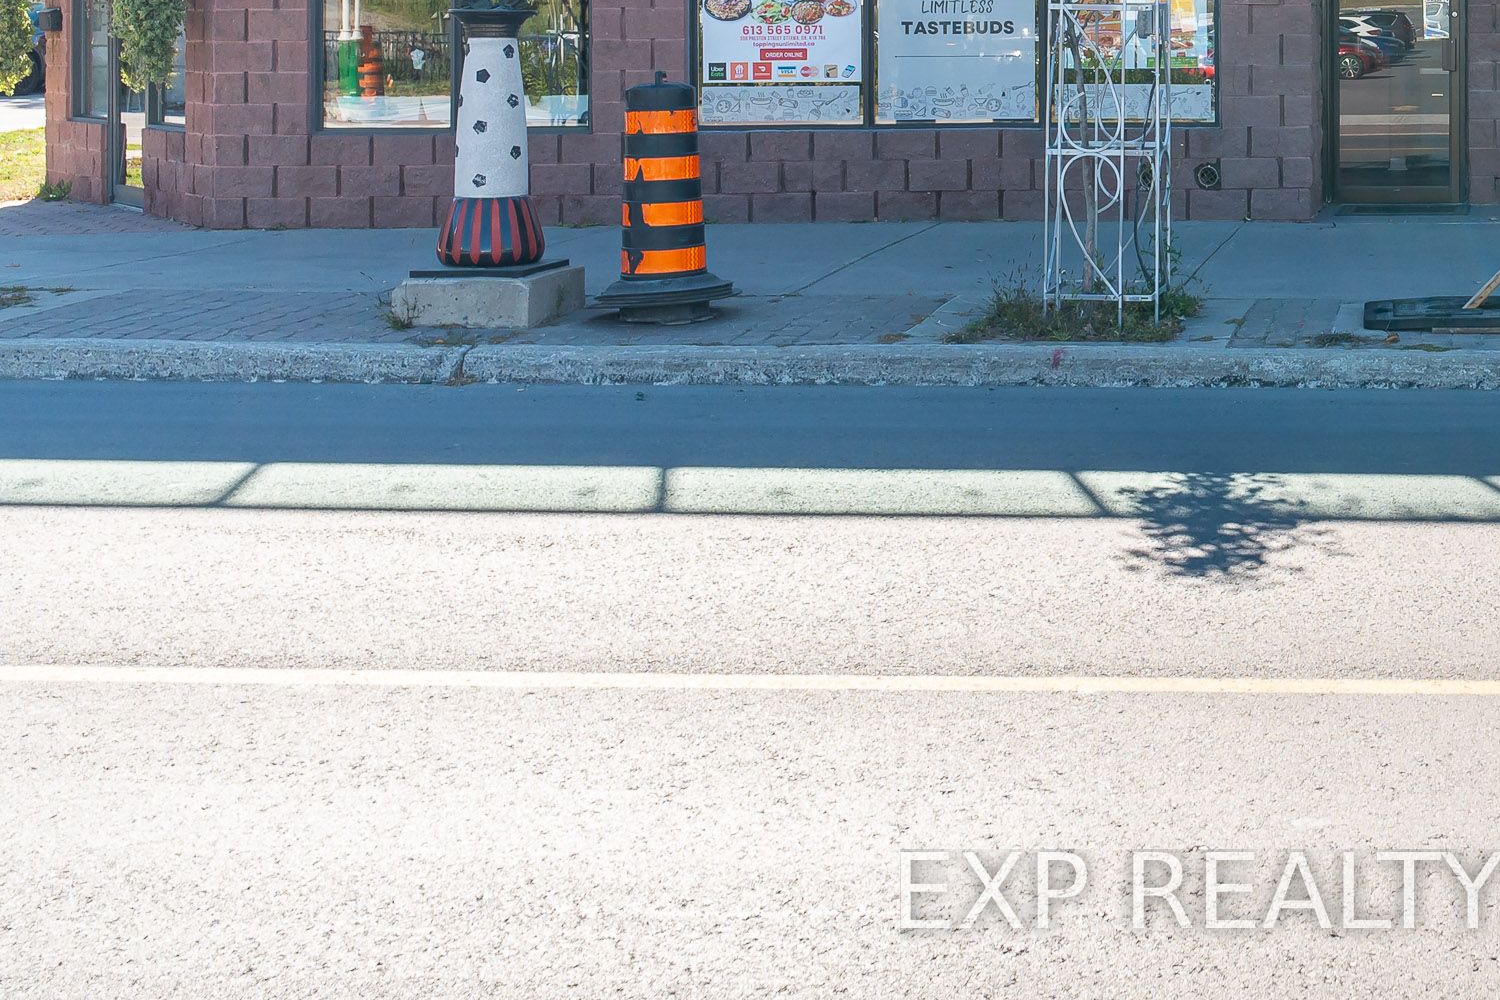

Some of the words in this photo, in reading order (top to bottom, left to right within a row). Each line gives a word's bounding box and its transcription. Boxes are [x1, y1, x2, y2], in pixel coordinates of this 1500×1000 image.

[921, 0, 994, 14] LIMITLESS
[742, 26, 763, 35] 613
[767, 26, 791, 35] 565
[795, 25, 823, 35] 0971
[901, 20, 1015, 35] TASTEBUDS
